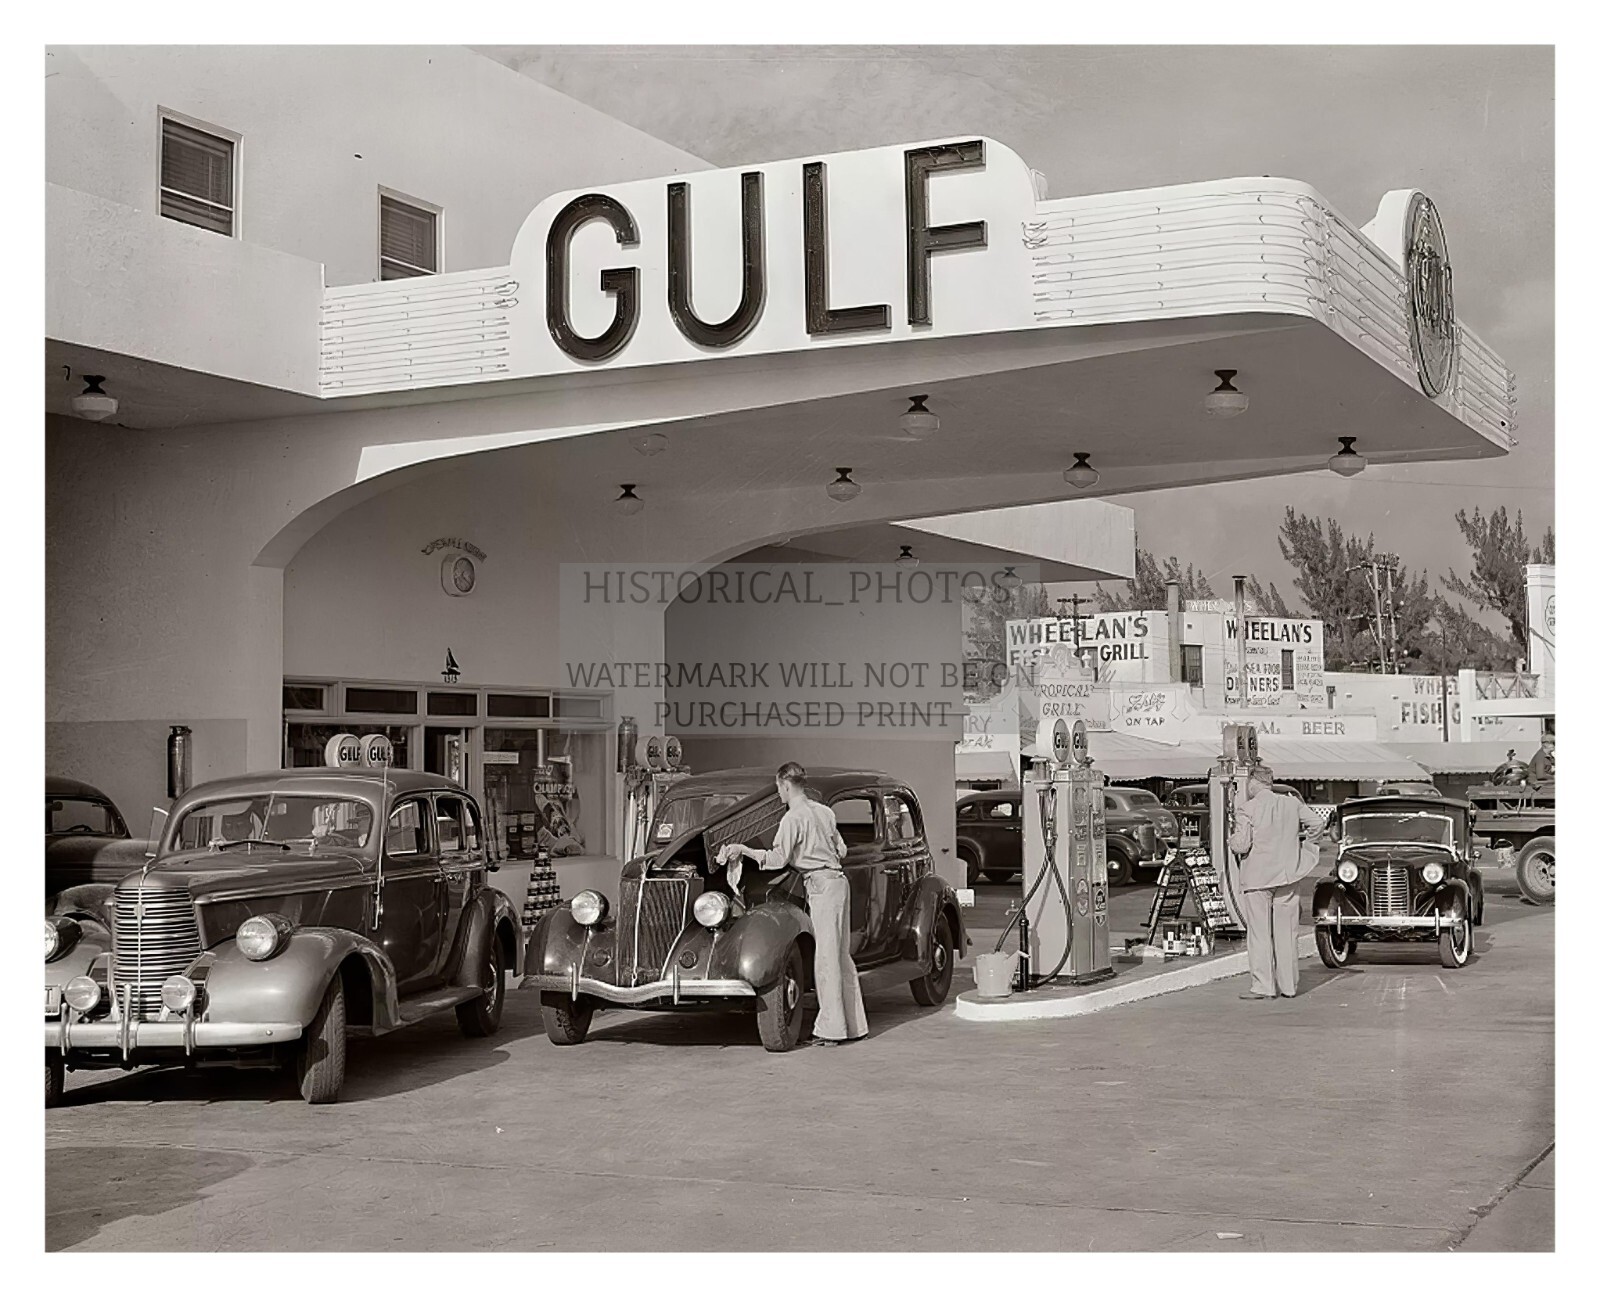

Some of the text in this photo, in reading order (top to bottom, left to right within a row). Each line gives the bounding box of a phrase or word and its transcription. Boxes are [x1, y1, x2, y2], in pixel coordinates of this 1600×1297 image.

[546, 139, 989, 361] GULF
[1010, 616, 1149, 645] WHEELAN'S
[1010, 643, 1149, 666] FIS GRILL
[1226, 676, 1280, 692] DINERS
[1042, 702, 1085, 716] GRILL
[1401, 702, 1442, 724] FISH
[1125, 717, 1165, 726] ON TAP
[1302, 721, 1345, 735] BEER
